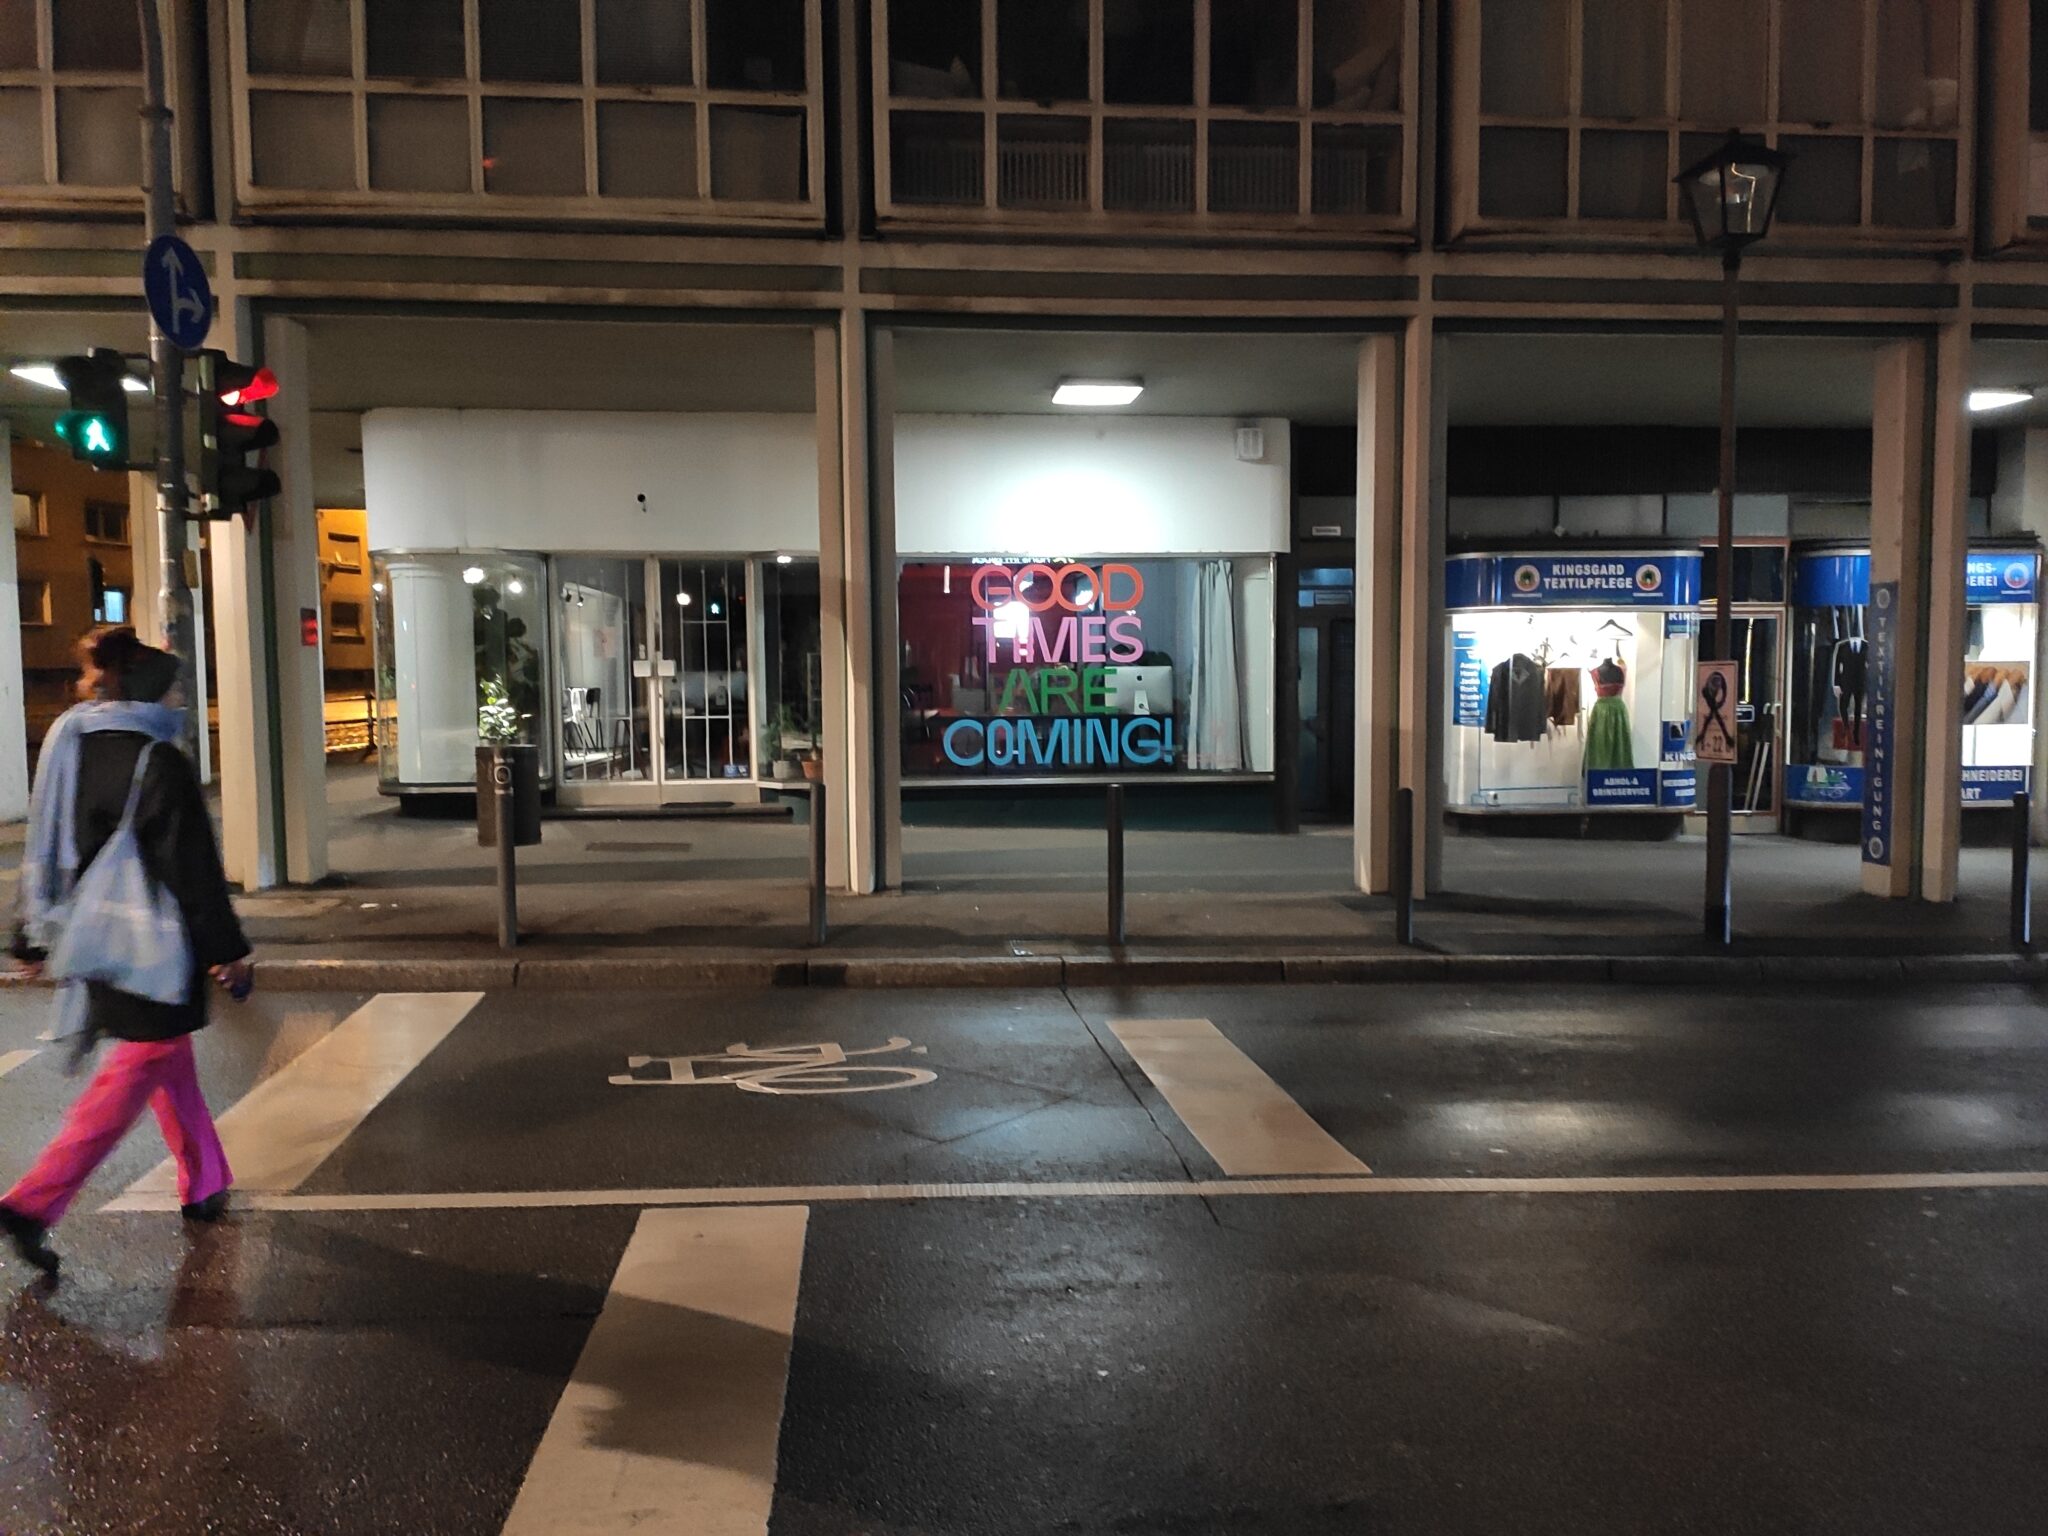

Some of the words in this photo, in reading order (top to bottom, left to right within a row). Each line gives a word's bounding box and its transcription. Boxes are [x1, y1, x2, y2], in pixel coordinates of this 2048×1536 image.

[970, 563, 1145, 612] GOOD
[1543, 577, 1633, 589] TEXTILPFLEGE
[1552, 563, 1625, 576] KINGSGARD
[1966, 575, 1998, 587] EREI
[971, 616, 1145, 664] TIMES
[998, 667, 1118, 714] ARE
[943, 716, 1173, 767] COMING!
[1871, 615, 1887, 831] TEXTILREINIGUNG
